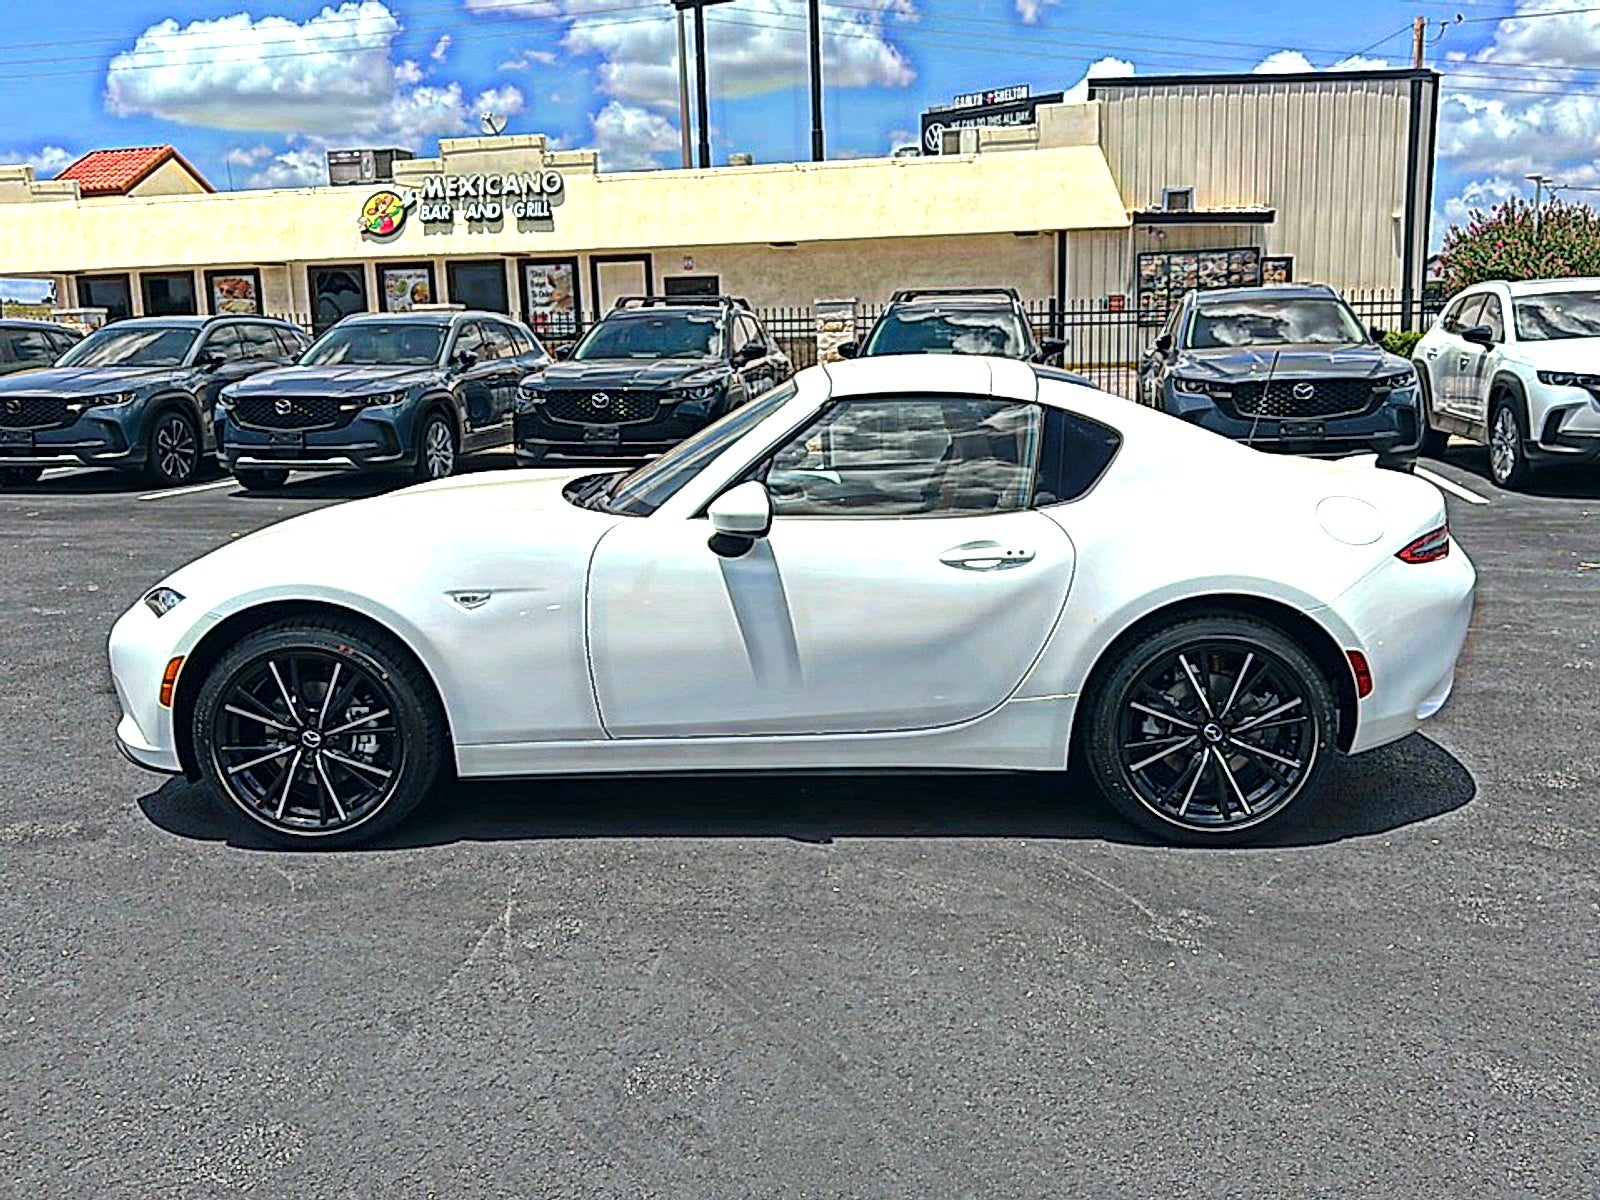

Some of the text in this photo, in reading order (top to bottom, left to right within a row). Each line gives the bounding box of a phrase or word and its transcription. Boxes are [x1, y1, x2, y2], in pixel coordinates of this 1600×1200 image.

[421, 172, 561, 198] MEXICANO
[420, 201, 550, 220] BAR AND GRILL
